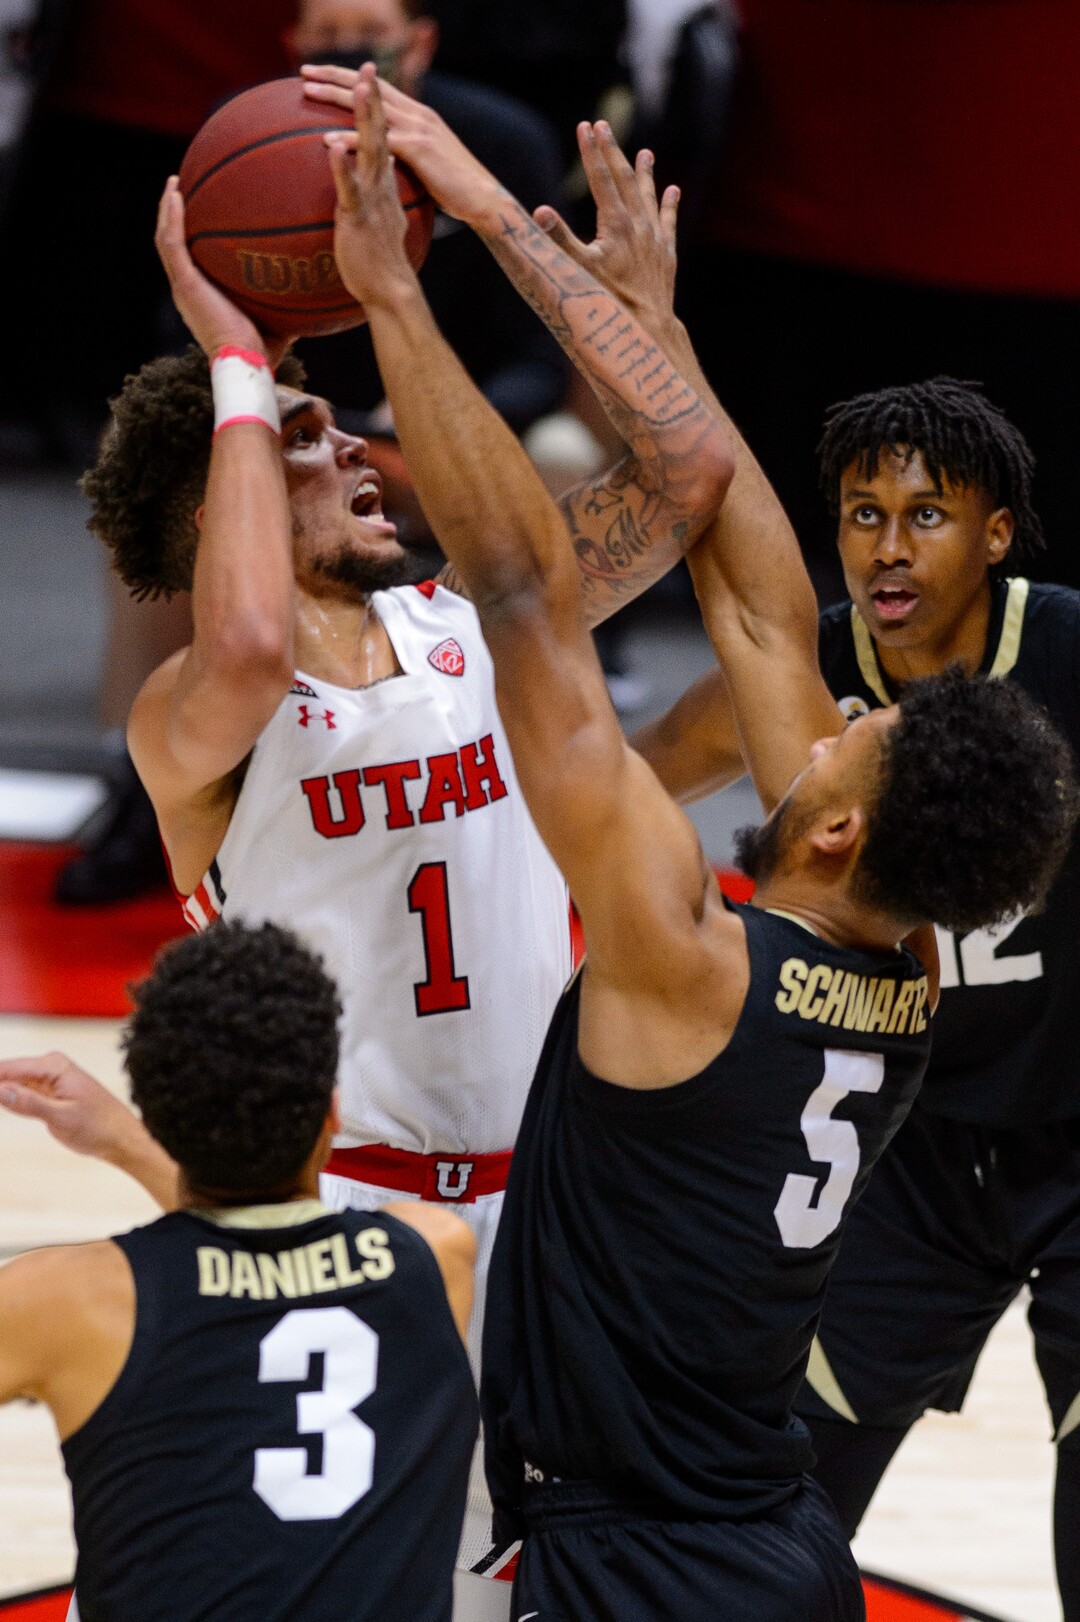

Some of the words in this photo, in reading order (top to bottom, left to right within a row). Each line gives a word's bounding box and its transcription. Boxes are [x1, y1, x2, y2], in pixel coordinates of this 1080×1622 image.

[301, 733, 508, 839] UTAH
[407, 861, 471, 1017] 1
[436, 1161, 473, 1198] U
[774, 1049, 884, 1248] 5
[196, 1227, 395, 1299] DANIELS
[252, 1305, 379, 1521] 3
